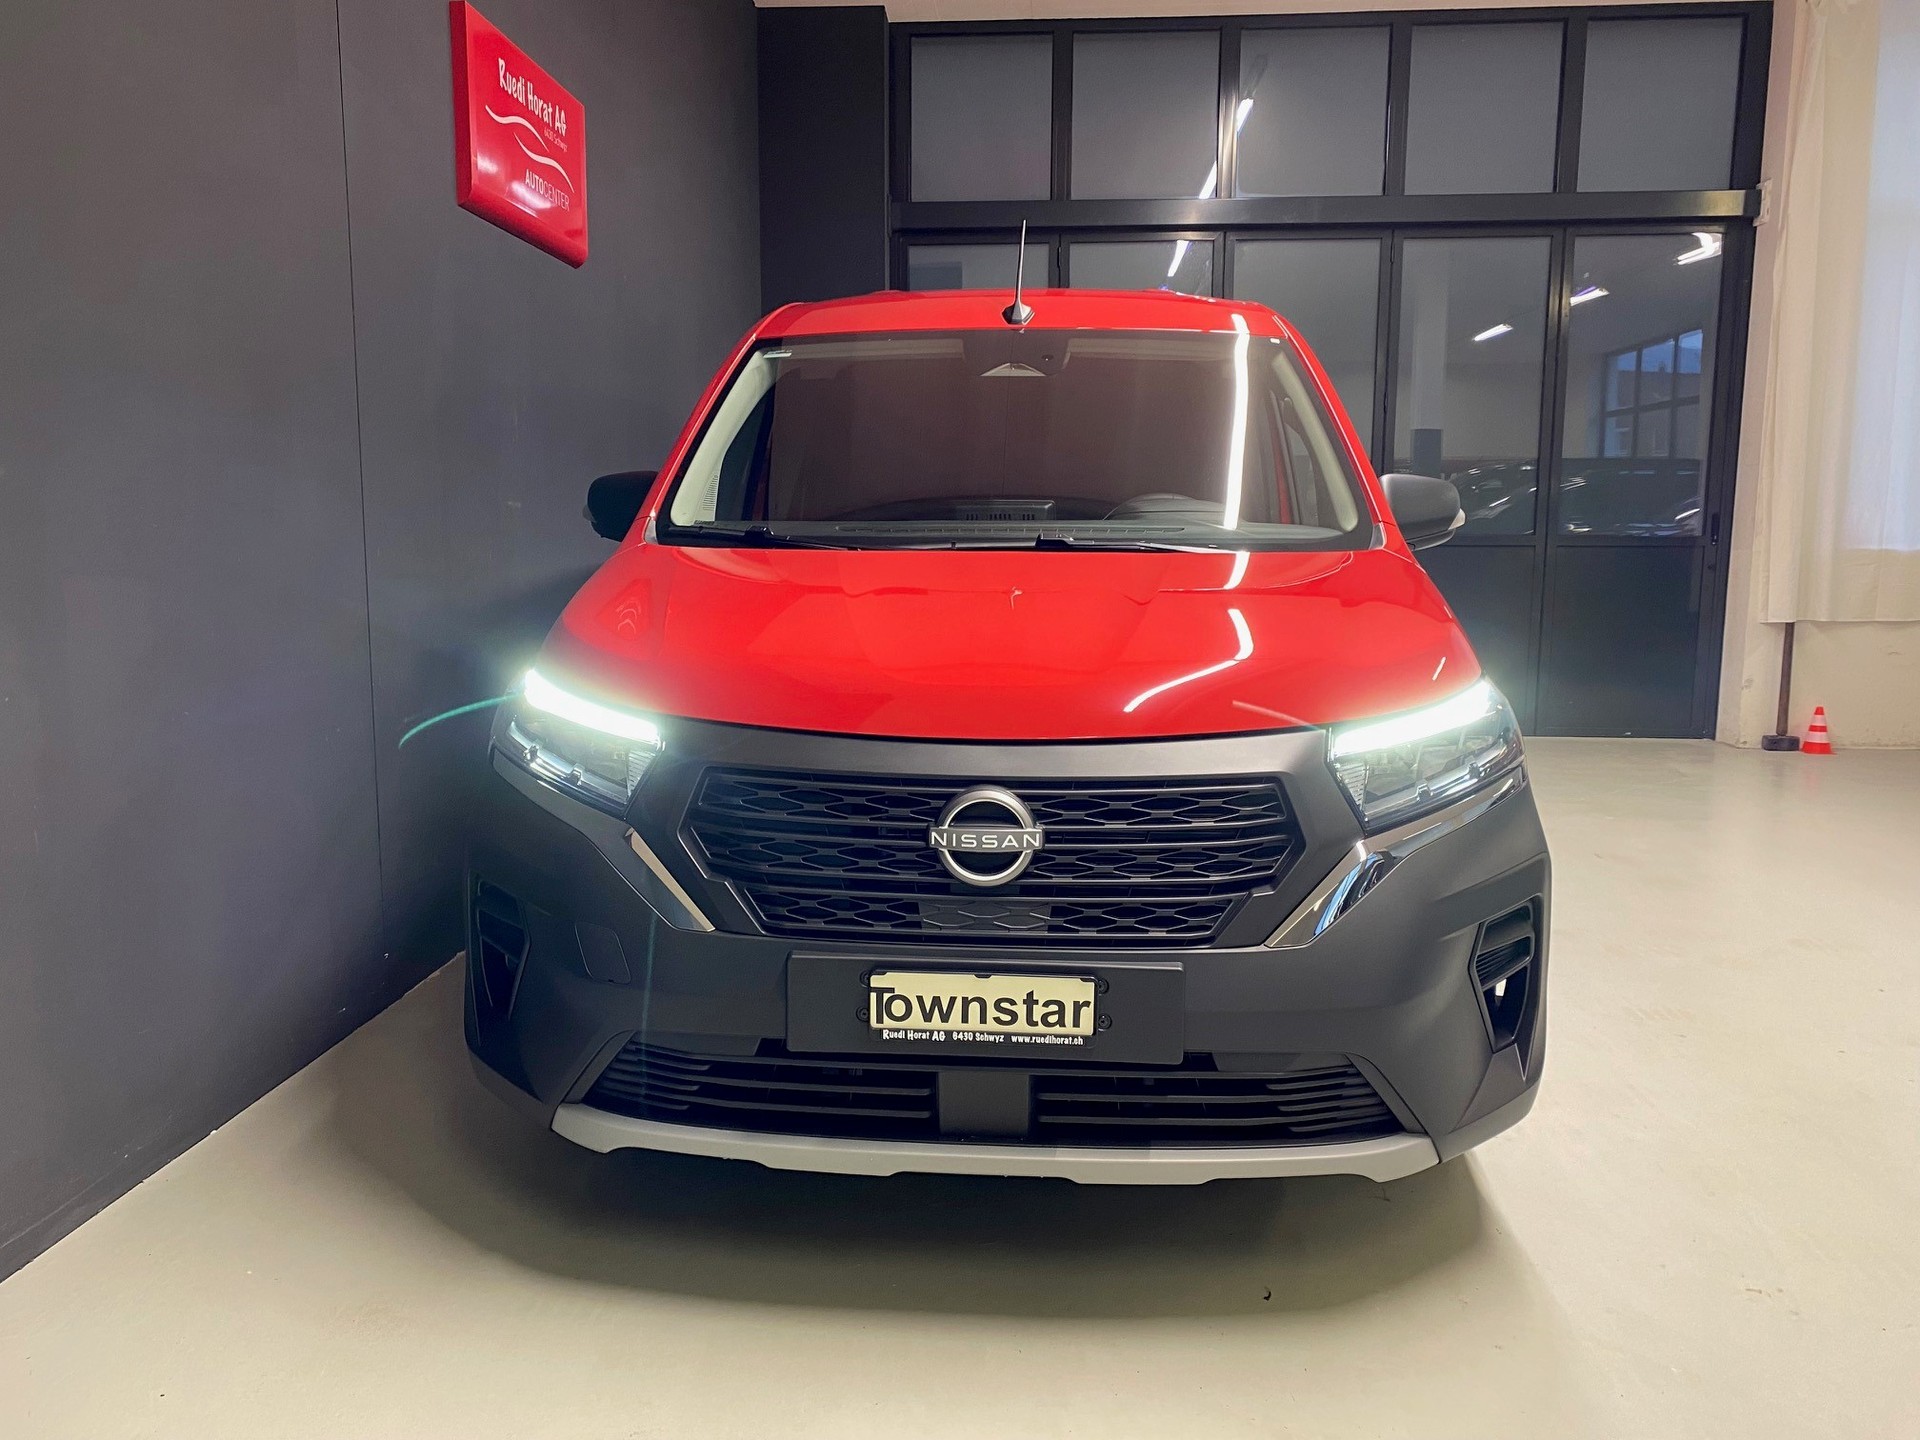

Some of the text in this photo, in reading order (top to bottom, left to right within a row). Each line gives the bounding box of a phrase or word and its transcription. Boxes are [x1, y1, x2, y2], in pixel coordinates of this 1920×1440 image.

[498, 58, 567, 136] Ruedi Horat AG
[525, 168, 570, 211] AUTOCENTER
[931, 831, 1040, 848] NISSAN
[870, 987, 1091, 1028] Townstar
[883, 1029, 1084, 1045] Ruedi Horat AG 6430 Schwyz www.ruedihorat.ch
